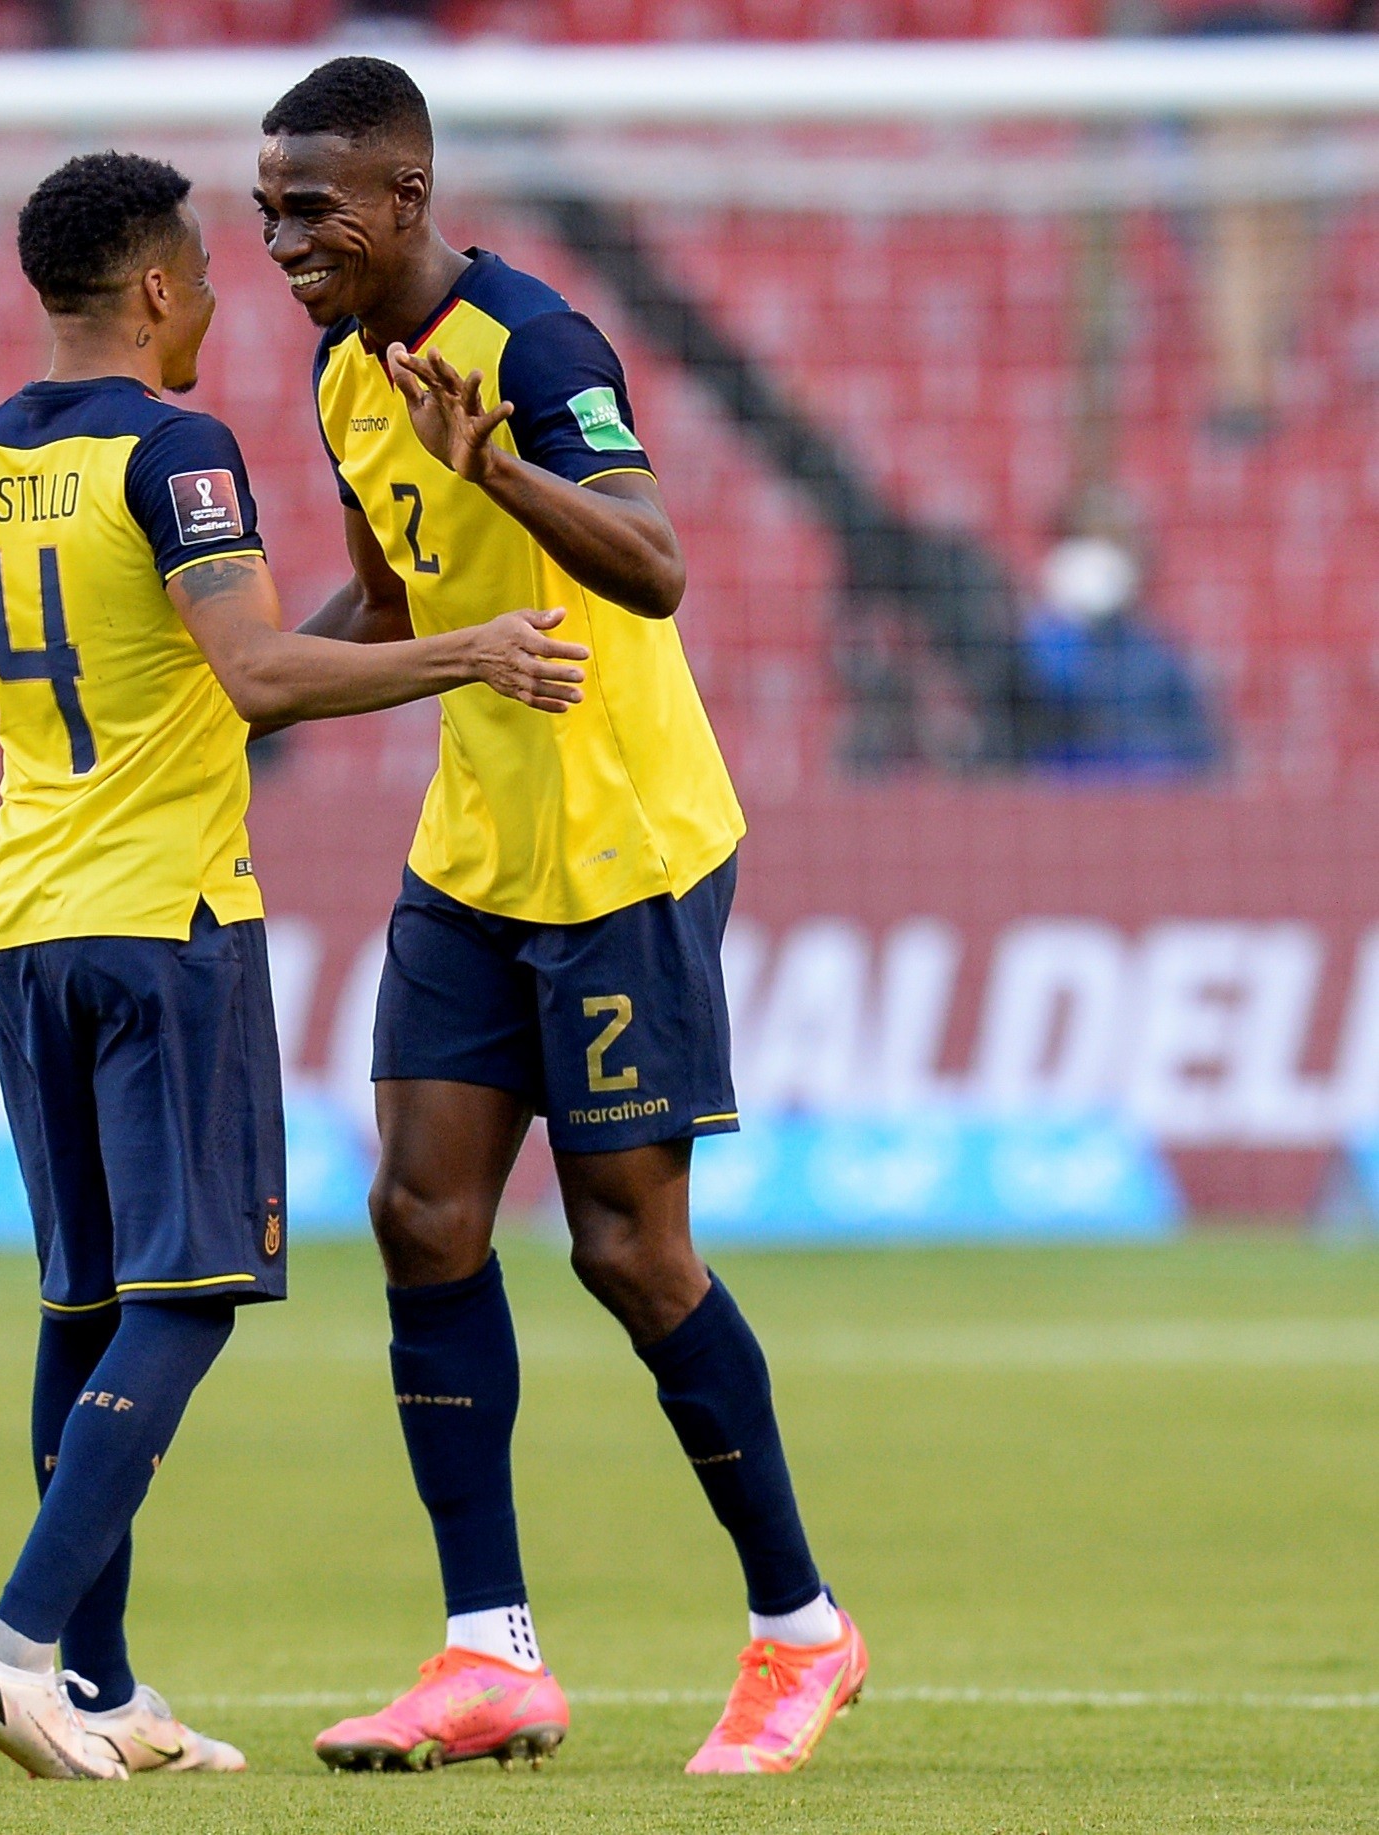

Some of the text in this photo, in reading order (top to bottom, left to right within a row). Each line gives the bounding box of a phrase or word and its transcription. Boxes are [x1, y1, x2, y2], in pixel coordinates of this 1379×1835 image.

[389, 482, 441, 575] 2
[582, 993, 639, 1092] 2
[568, 1097, 670, 1124] marathon
[78, 1391, 135, 1412] FEF
